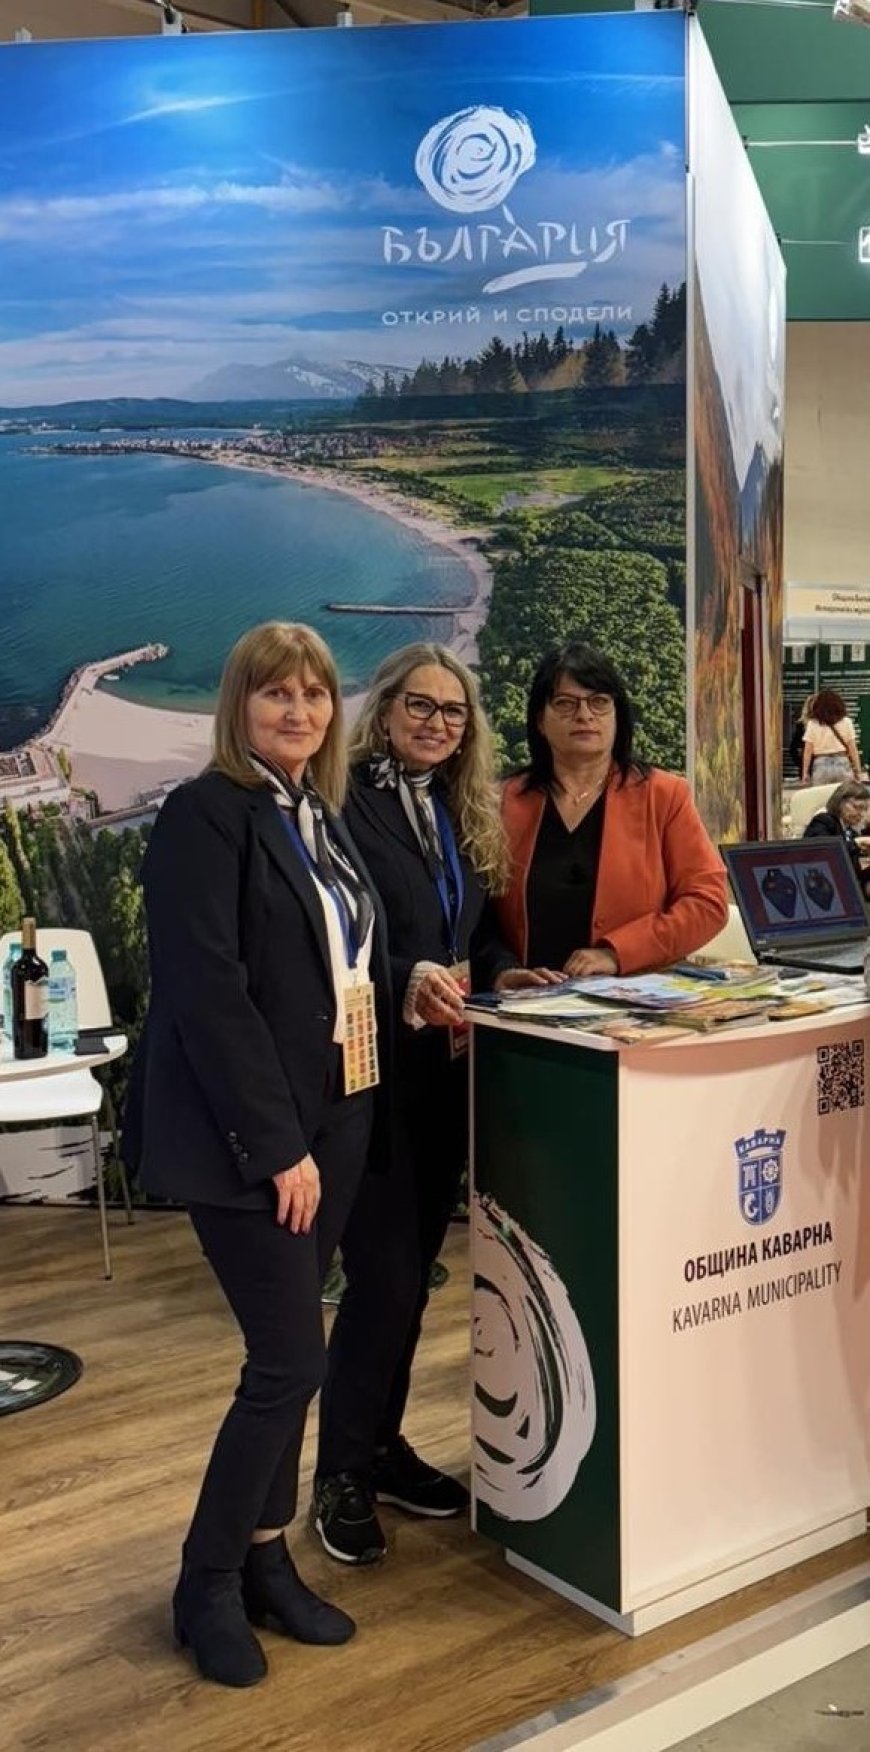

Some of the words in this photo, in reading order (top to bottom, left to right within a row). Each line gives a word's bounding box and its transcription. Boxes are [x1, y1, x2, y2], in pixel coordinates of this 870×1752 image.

[381, 212, 631, 264] БЪЛГАРИЯ
[382, 306, 480, 326] ОТКРИЙ
[493, 309, 508, 323] И
[517, 305, 633, 324] СПОДЕЛИ
[684, 1242, 757, 1283] ОБЩИНА
[761, 1221, 833, 1261] КАВАРНА
[672, 1291, 742, 1333] KAVARNA
[747, 1260, 843, 1309] MUNICIPALITY
